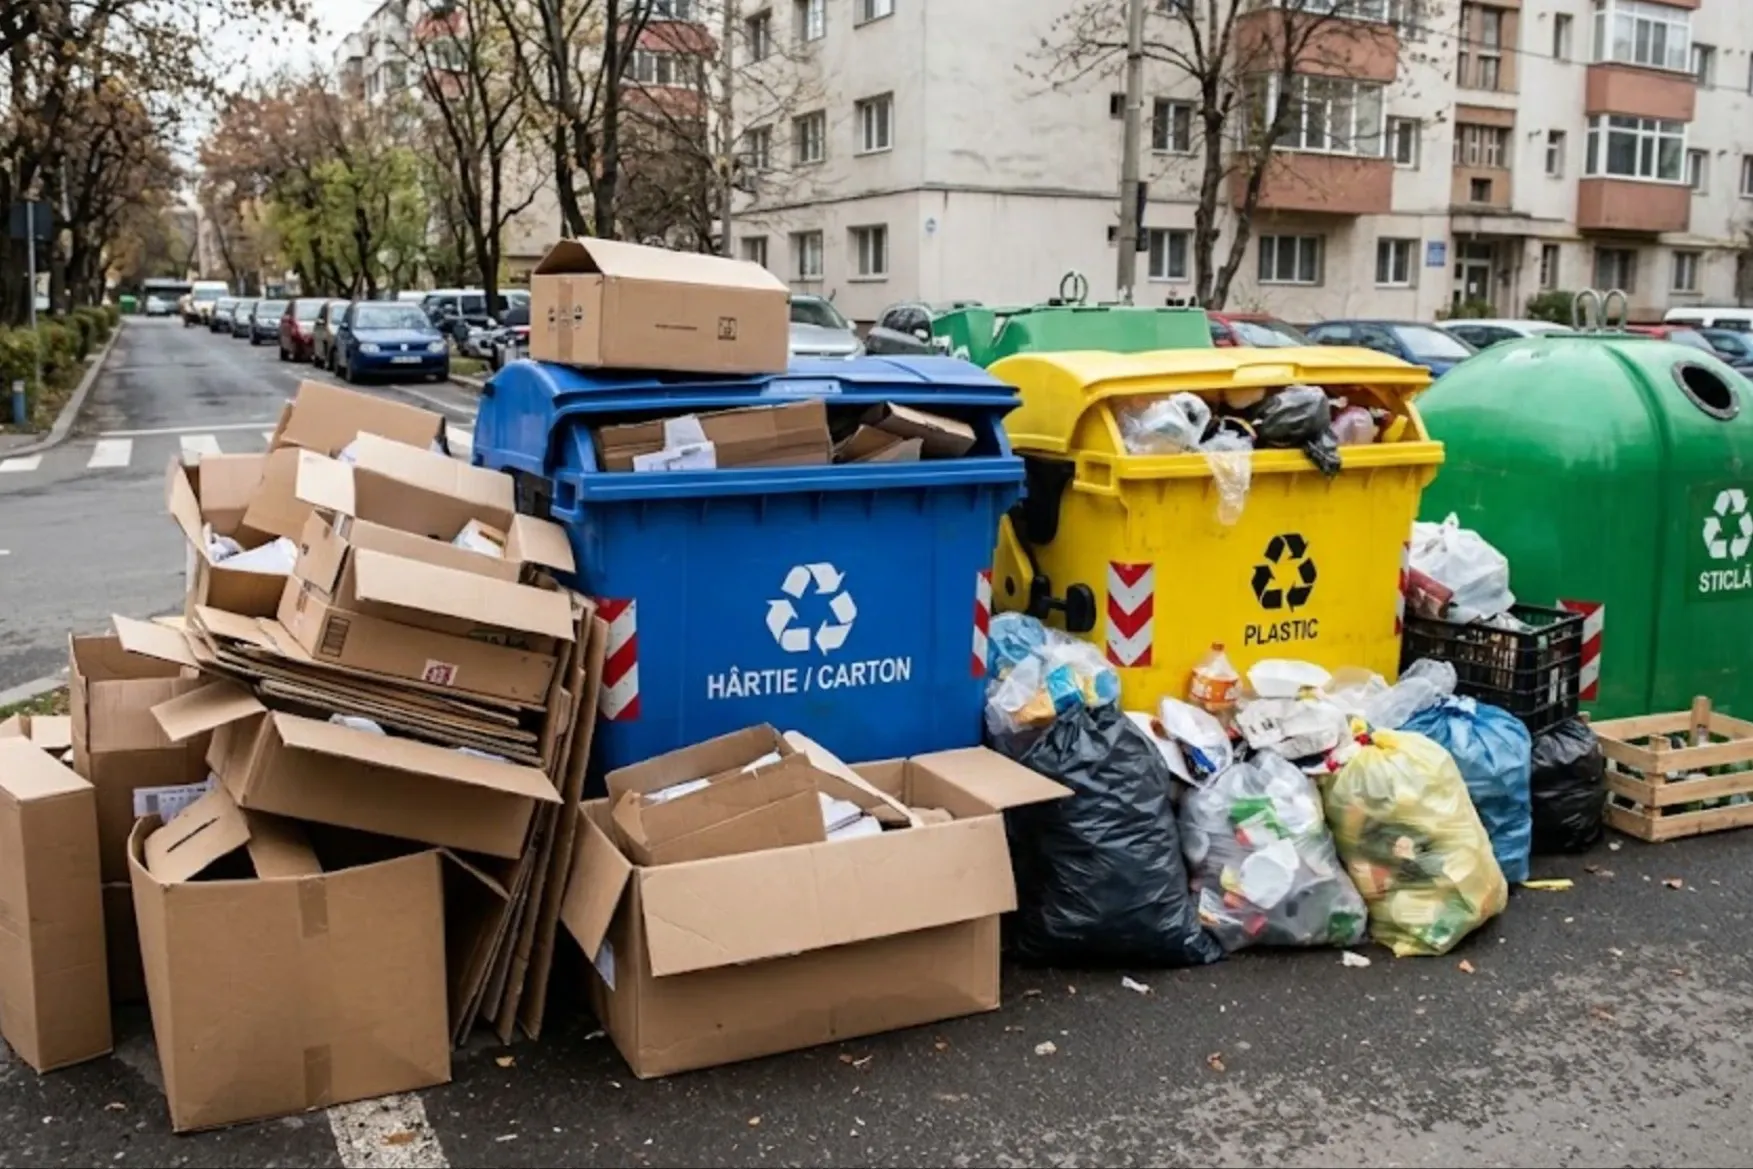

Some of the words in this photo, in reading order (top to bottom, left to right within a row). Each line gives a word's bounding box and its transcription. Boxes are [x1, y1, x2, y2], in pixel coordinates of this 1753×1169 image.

[1699, 563, 1752, 593] STICLĂ
[1244, 618, 1318, 647] PLASTIC
[707, 664, 798, 699] HÂRTIE
[804, 667, 813, 692] /
[817, 656, 911, 689] CARTON
